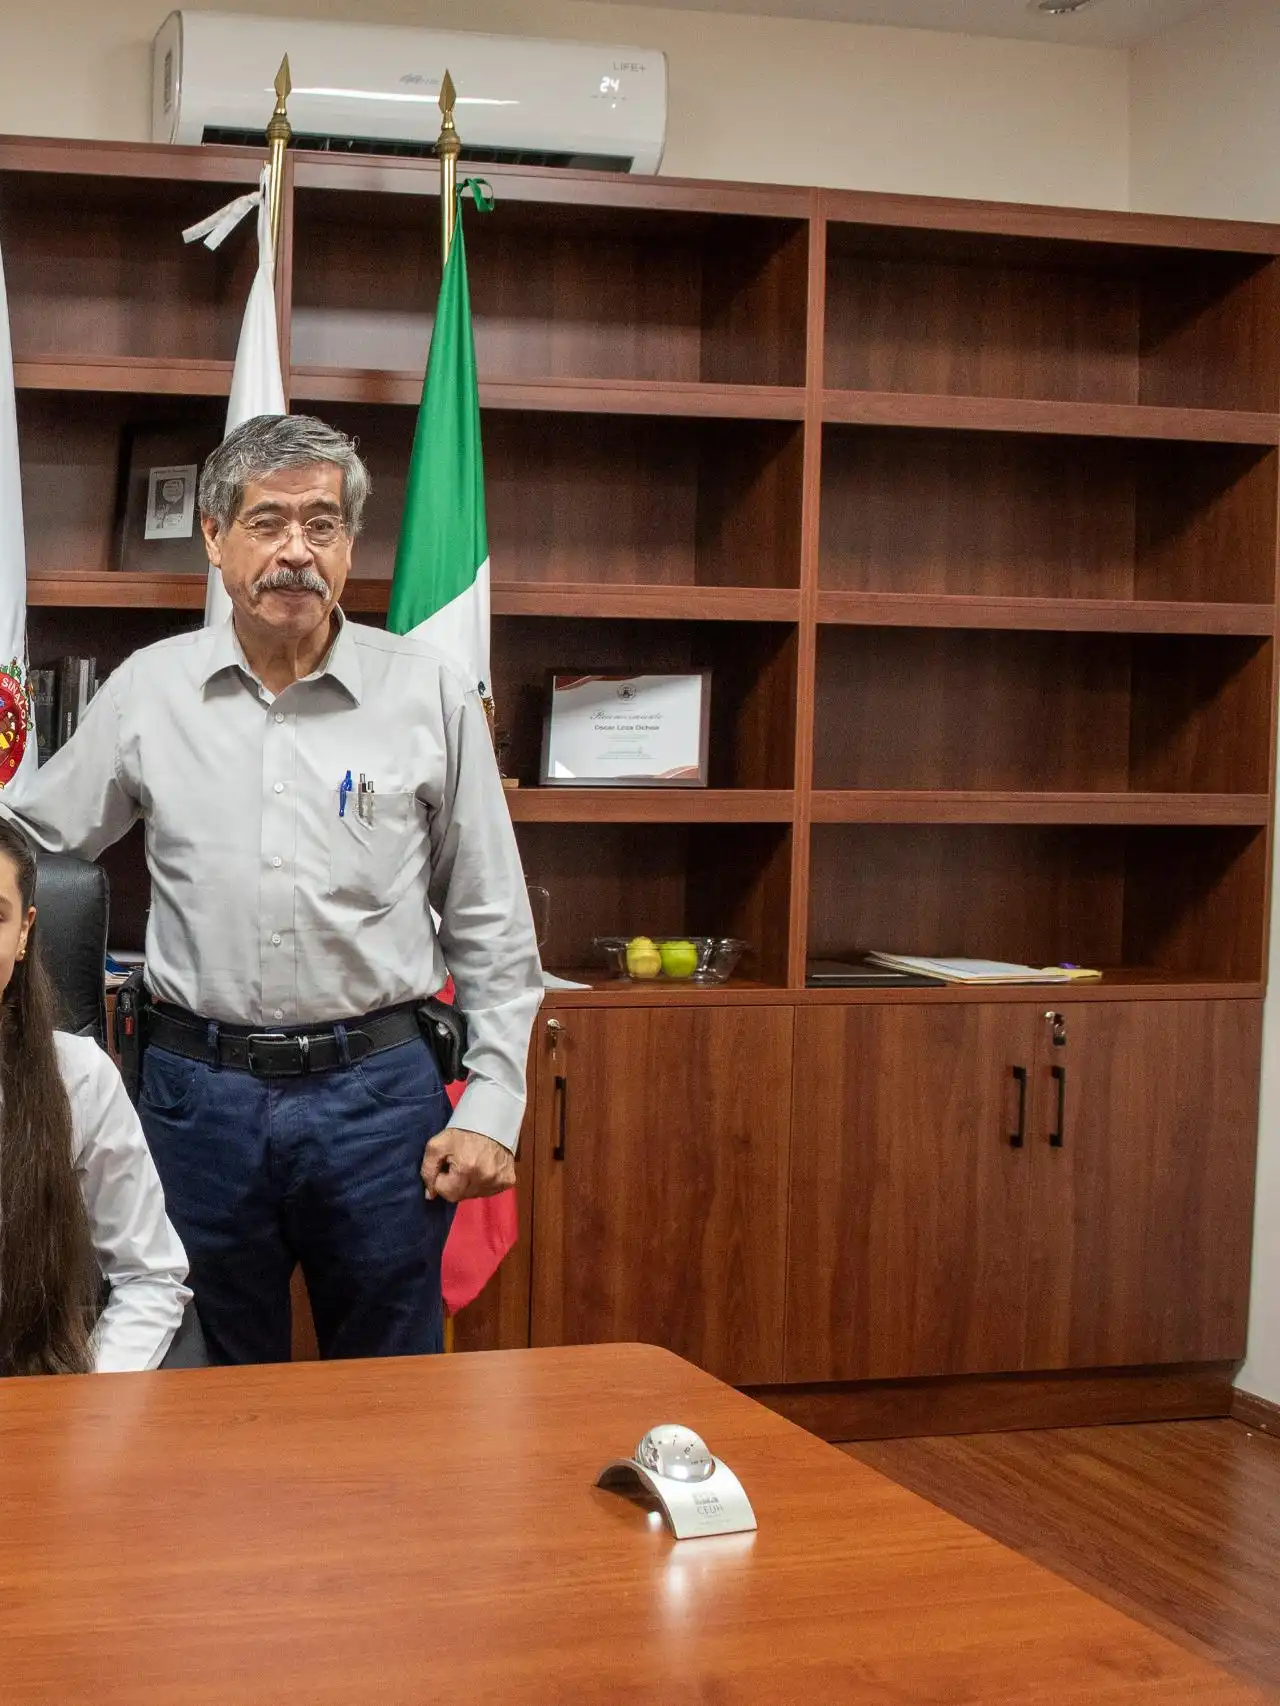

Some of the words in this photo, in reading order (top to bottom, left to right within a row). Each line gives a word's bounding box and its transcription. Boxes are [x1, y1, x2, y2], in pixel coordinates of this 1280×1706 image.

[613, 61, 646, 73] LIFE+
[600, 76, 620, 93] 24
[1, 677, 27, 730] SINALOA
